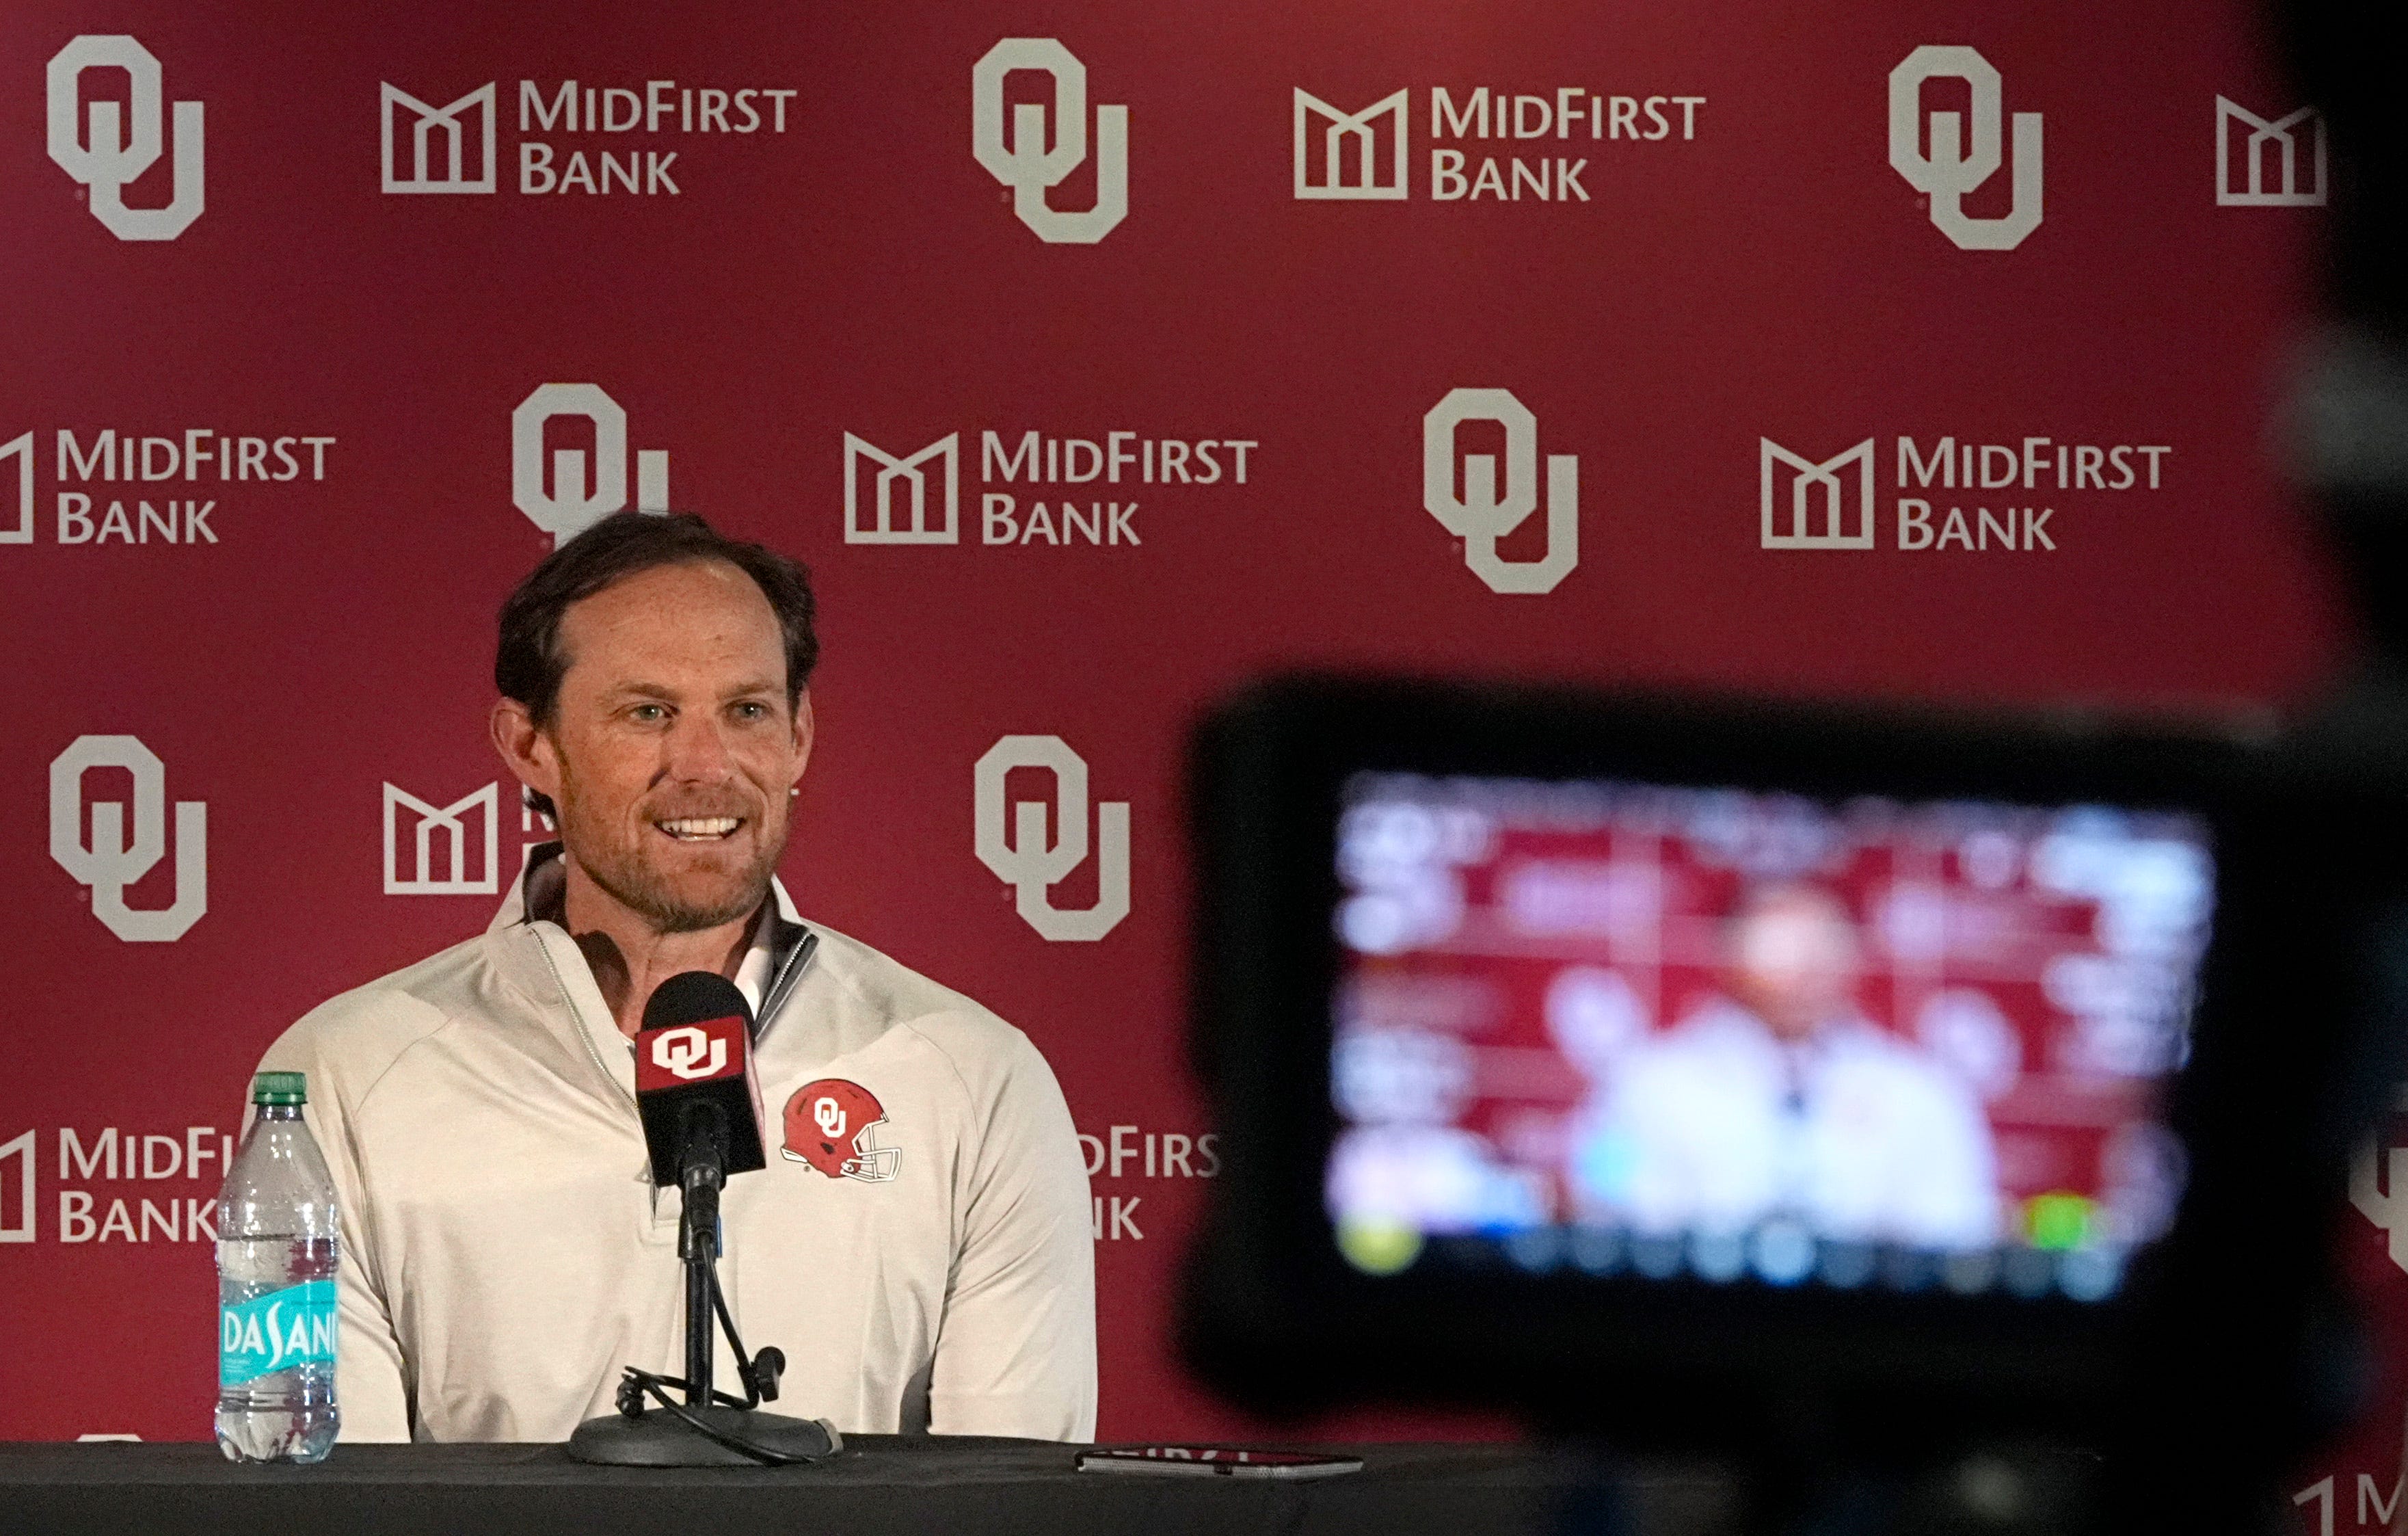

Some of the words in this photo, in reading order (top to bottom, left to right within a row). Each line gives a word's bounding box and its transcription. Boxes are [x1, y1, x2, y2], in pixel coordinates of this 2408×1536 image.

[46, 35, 204, 241] OU
[973, 38, 1128, 243] OU
[1889, 45, 2043, 250] OU
[520, 143, 680, 195] BANK
[1431, 149, 1591, 202] BANK
[1423, 388, 1579, 594] OU
[57, 492, 219, 544] BANK
[982, 494, 1141, 546] BANK
[1897, 499, 2057, 551] BANK
[50, 735, 206, 942] OU
[974, 735, 1130, 942] OU
[652, 1027, 727, 1080] OU
[814, 1097, 846, 1138] OU
[60, 1127, 233, 1180] MIDFI
[60, 1191, 218, 1243] BANK
